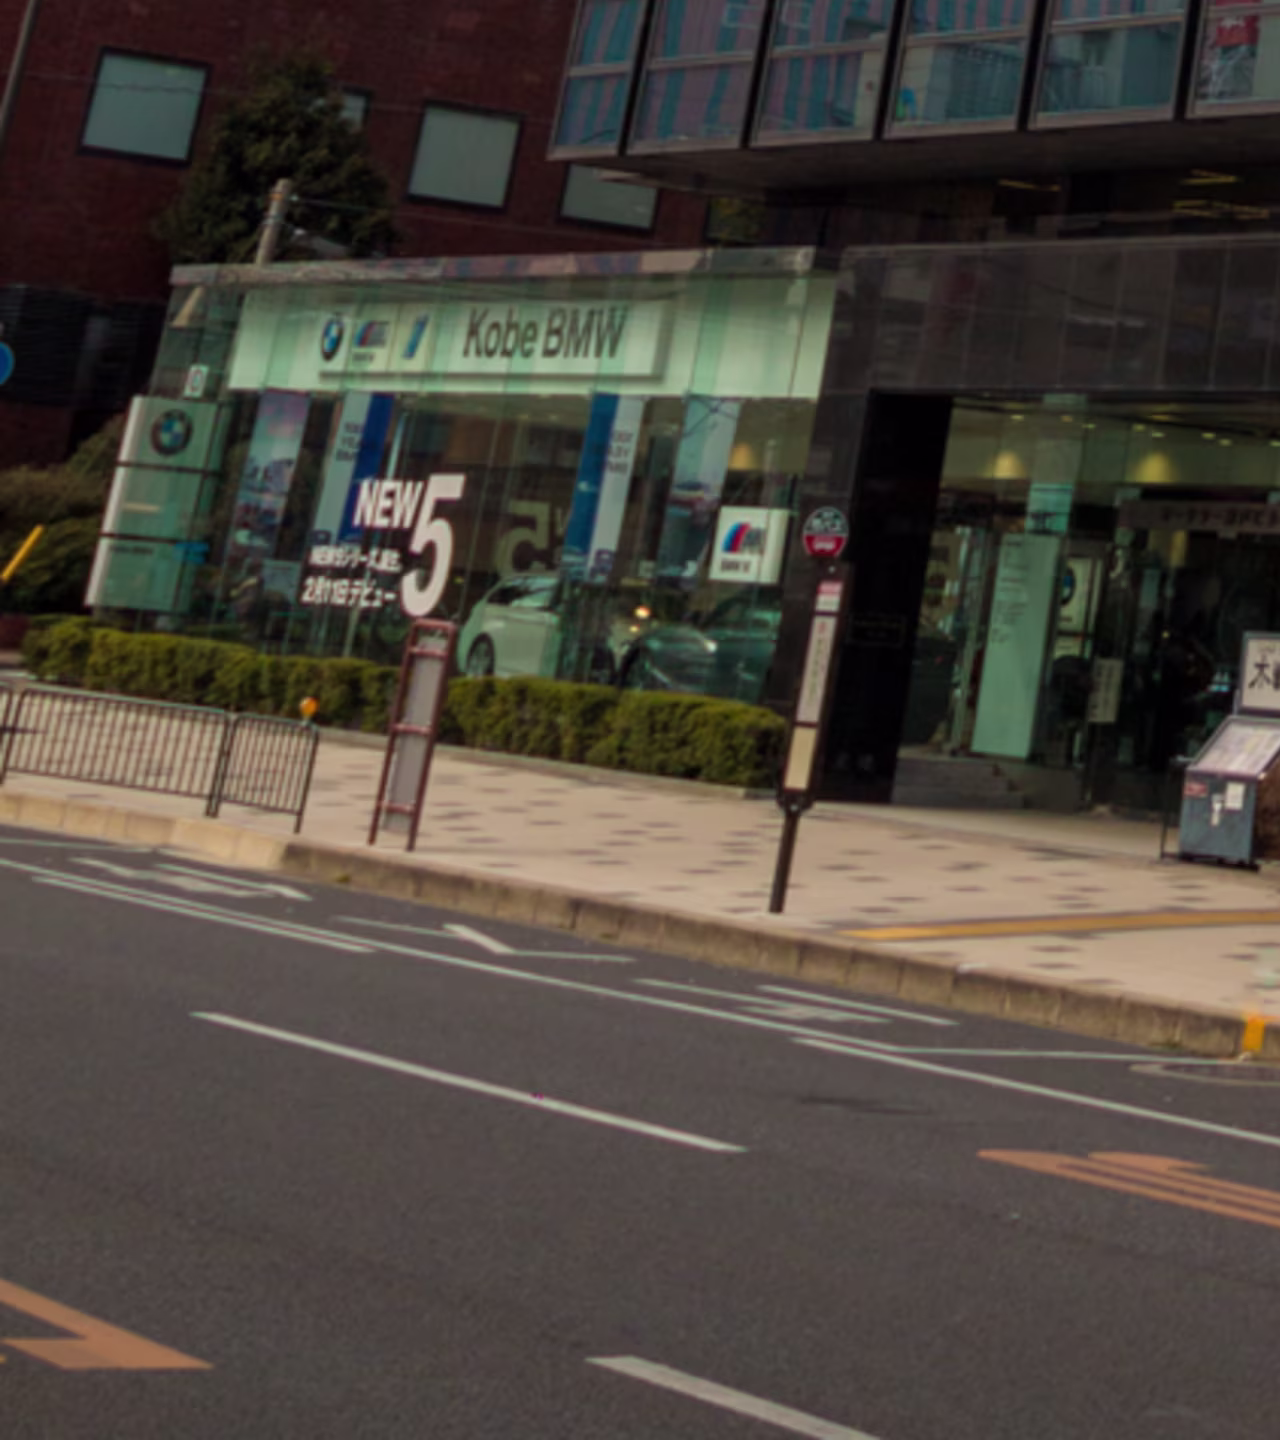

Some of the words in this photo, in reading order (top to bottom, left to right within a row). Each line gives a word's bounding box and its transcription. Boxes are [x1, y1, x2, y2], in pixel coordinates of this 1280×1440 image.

[462, 308, 540, 358] Kobe
[541, 308, 628, 359] BMW
[354, 469, 424, 529] NEW
[401, 473, 466, 617] 5
